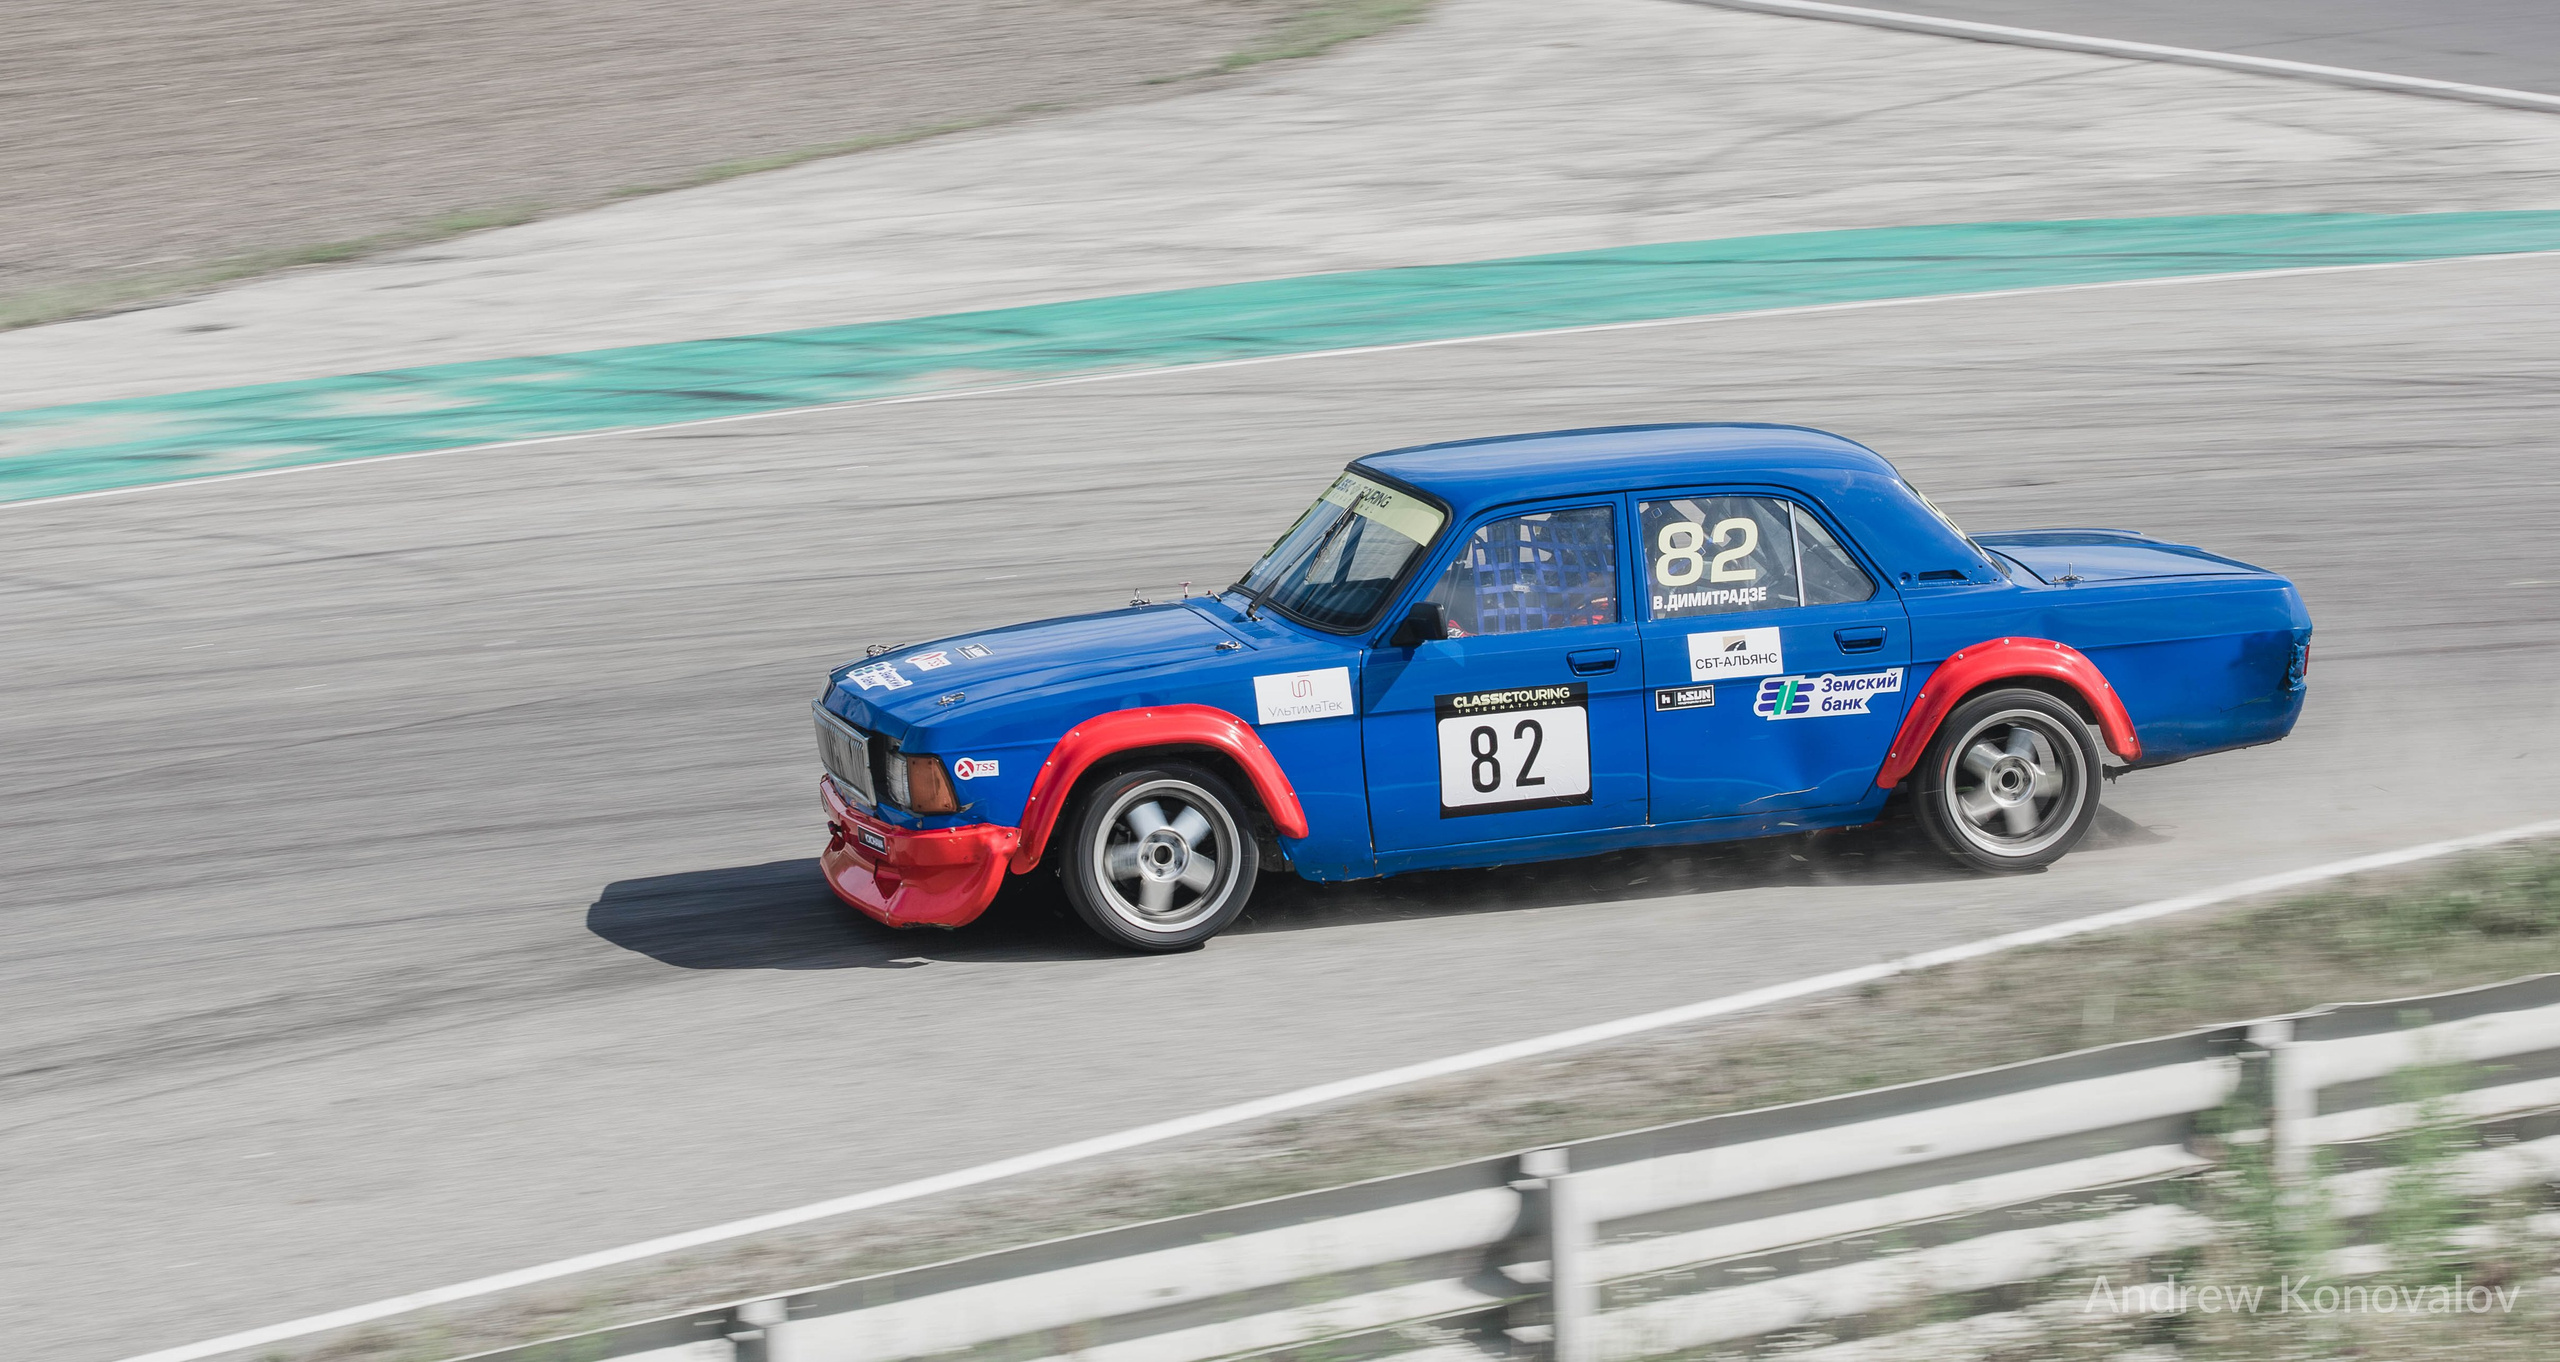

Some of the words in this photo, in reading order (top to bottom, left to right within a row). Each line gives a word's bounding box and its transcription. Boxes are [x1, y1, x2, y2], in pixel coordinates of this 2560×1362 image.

[1656, 517, 1758, 587] 82
[1653, 586, 1767, 612] В.ДИМИТРАДЗЕ
[1695, 652, 1778, 670] СБТ-АЛЬЯНС
[1821, 672, 1898, 693] Земский
[1267, 700, 1344, 718] УльтимаТек
[1458, 699, 1566, 714] INTERNATIONAL
[1821, 695, 1863, 712] банк
[1470, 719, 1546, 794] 82
[975, 762, 996, 772] TSS
